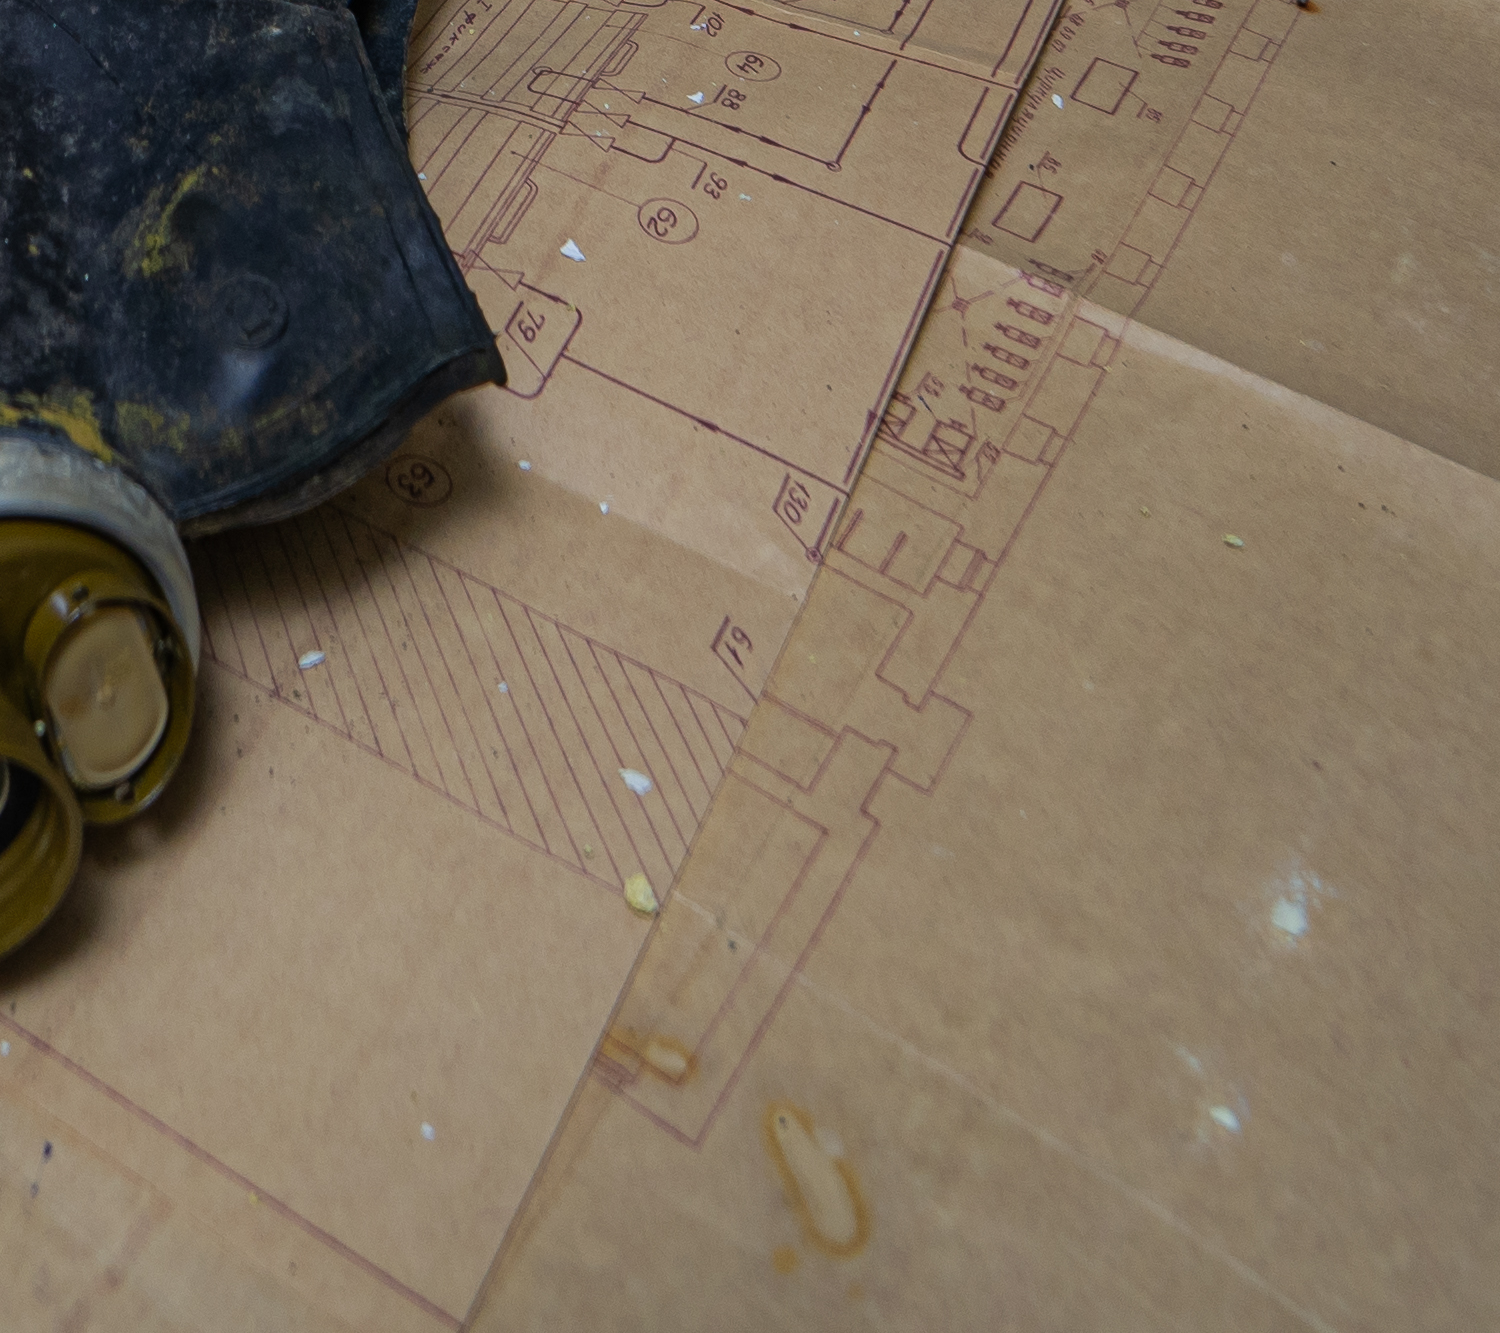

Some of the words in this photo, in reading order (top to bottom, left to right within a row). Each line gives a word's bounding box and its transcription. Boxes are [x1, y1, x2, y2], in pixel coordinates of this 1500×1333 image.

[419, 9, 478, 75] фиксаж
[736, 53, 765, 77] 64
[720, 87, 748, 111] 88
[703, 169, 730, 202] 93
[646, 204, 680, 240] 62
[516, 309, 548, 345] 79
[398, 465, 437, 500] 63
[782, 481, 814, 526] 130
